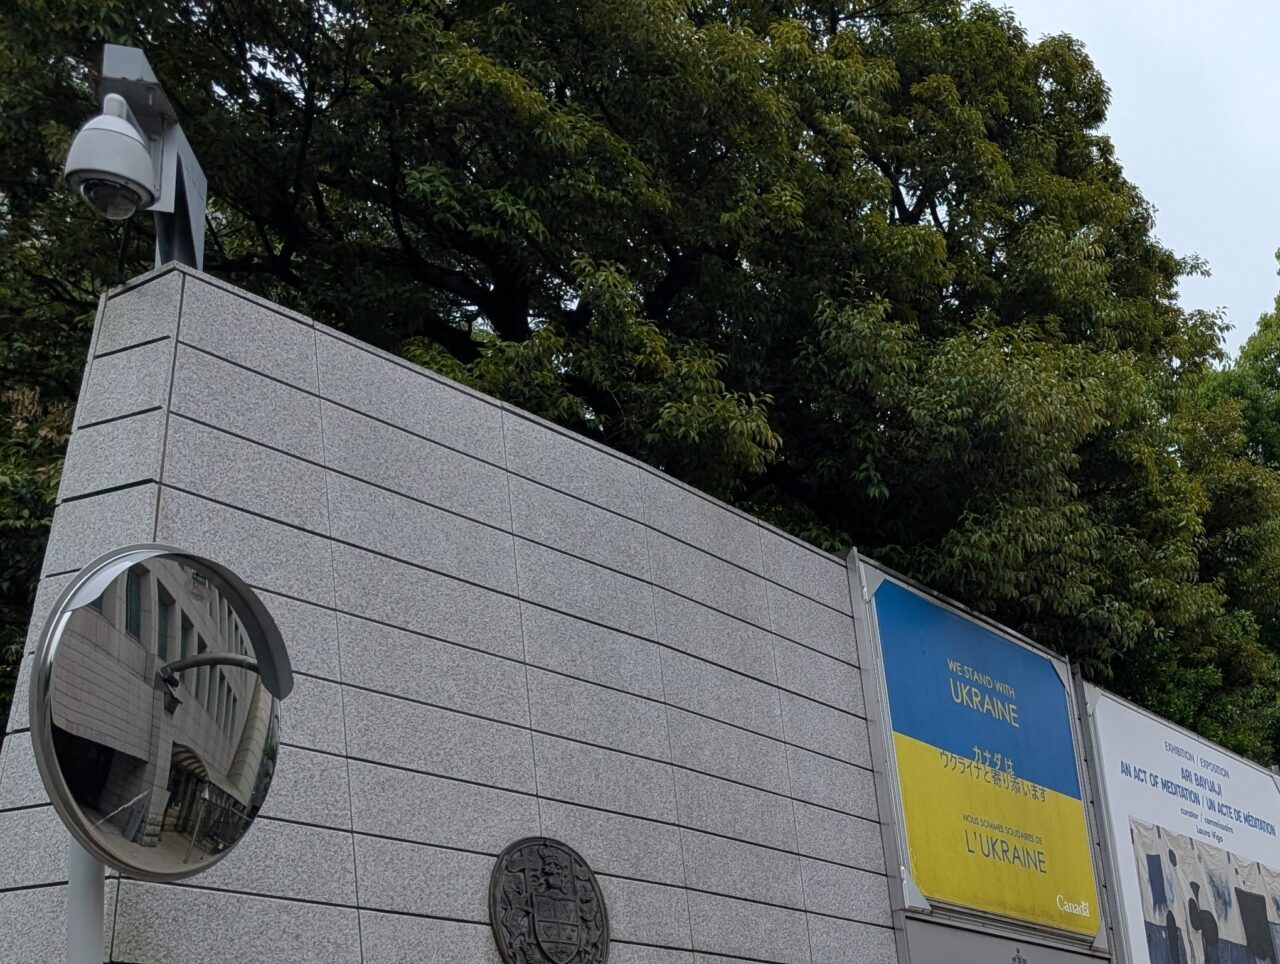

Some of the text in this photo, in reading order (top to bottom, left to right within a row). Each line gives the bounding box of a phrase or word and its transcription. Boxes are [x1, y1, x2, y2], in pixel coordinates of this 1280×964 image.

[947, 658, 1016, 701] WE STAND WITH
[950, 678, 1020, 728] UKRAINE
[972, 746, 1016, 776] カナダは
[1165, 740, 1195, 764] EXHIBITION
[1200, 757, 1230, 779] EXPOSITION
[1120, 760, 1132, 778] AN
[1133, 765, 1147, 784] ACT
[1149, 772, 1159, 789] OF
[1160, 777, 1201, 806] MEDITATION
[1205, 796, 1217, 813] UN
[1217, 801, 1234, 820] ACTE
[1233, 808, 1243, 823] DE
[1181, 766, 1223, 797] ARI BAYUAJI
[963, 813, 980, 826] NOUS
[964, 829, 1048, 874] L'UKRAINE
[1056, 894, 1090, 917] Canada
